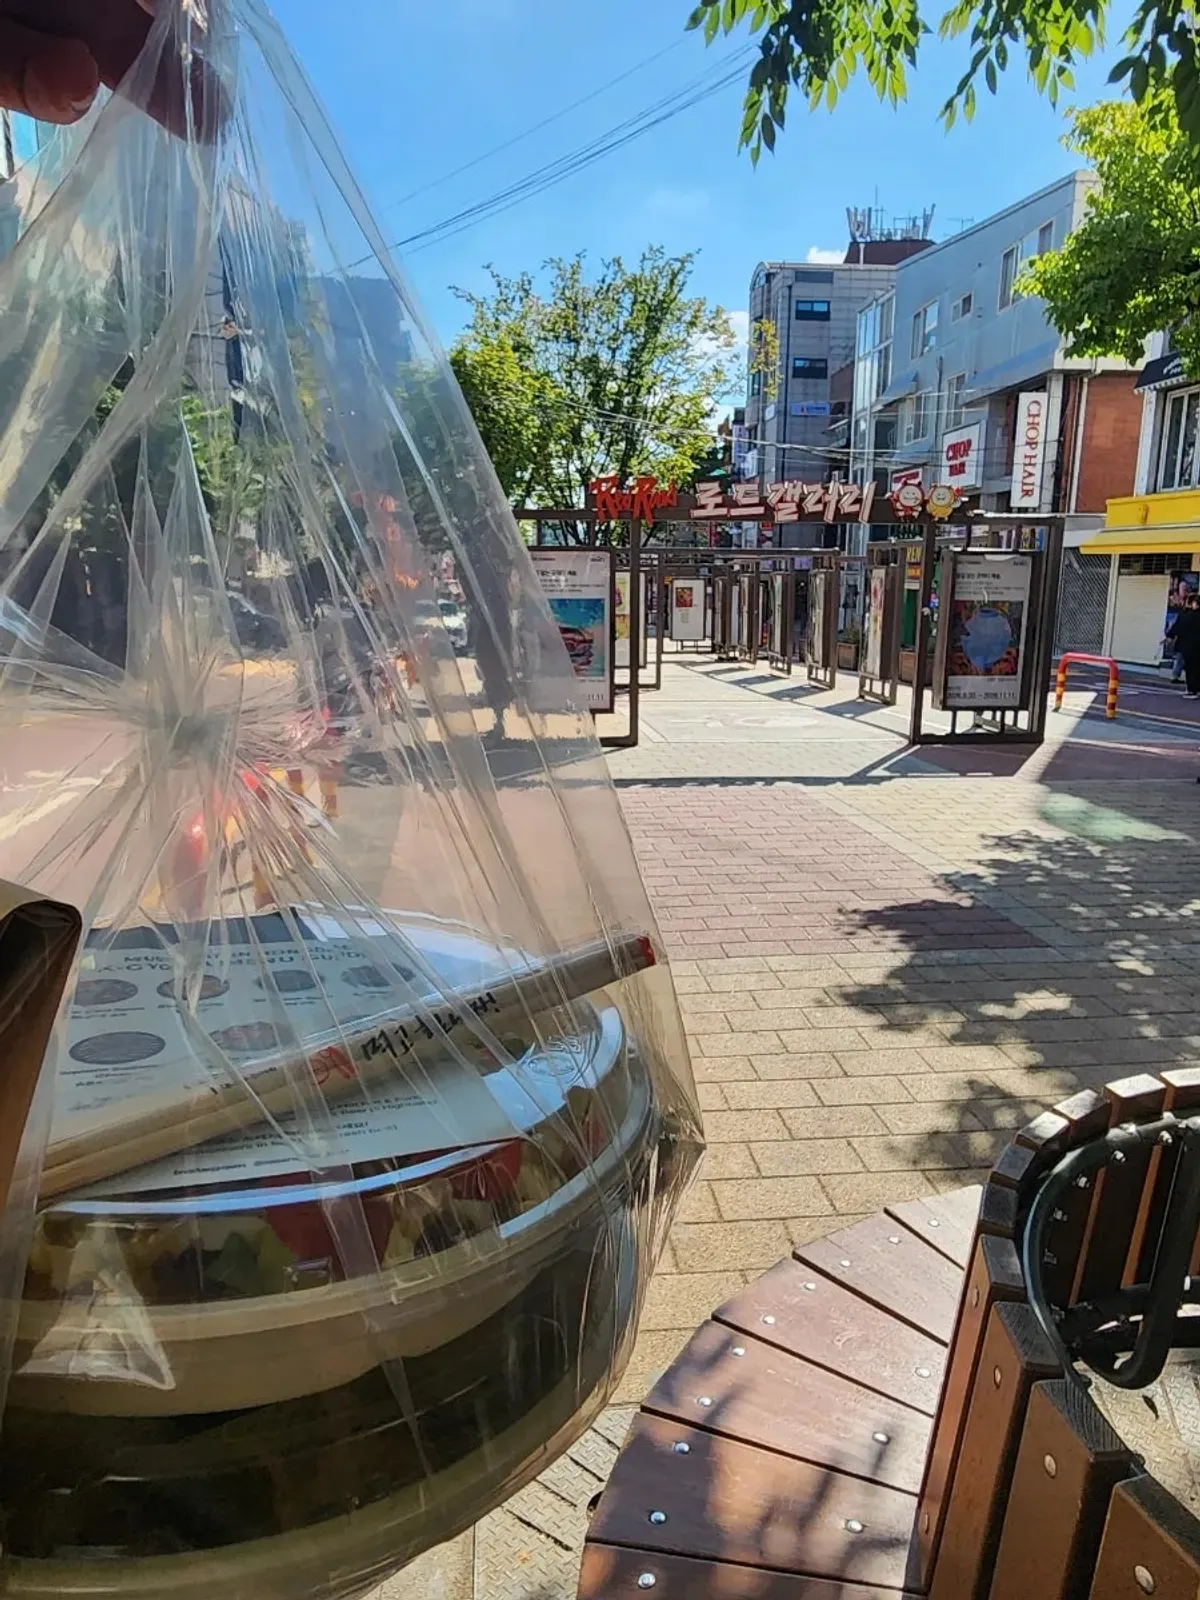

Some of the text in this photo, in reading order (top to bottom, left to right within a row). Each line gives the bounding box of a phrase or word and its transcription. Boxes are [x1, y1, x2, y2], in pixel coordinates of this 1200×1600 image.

[946, 438, 972, 462] CHOP
[1020, 399, 1042, 500] CHOP HAIR
